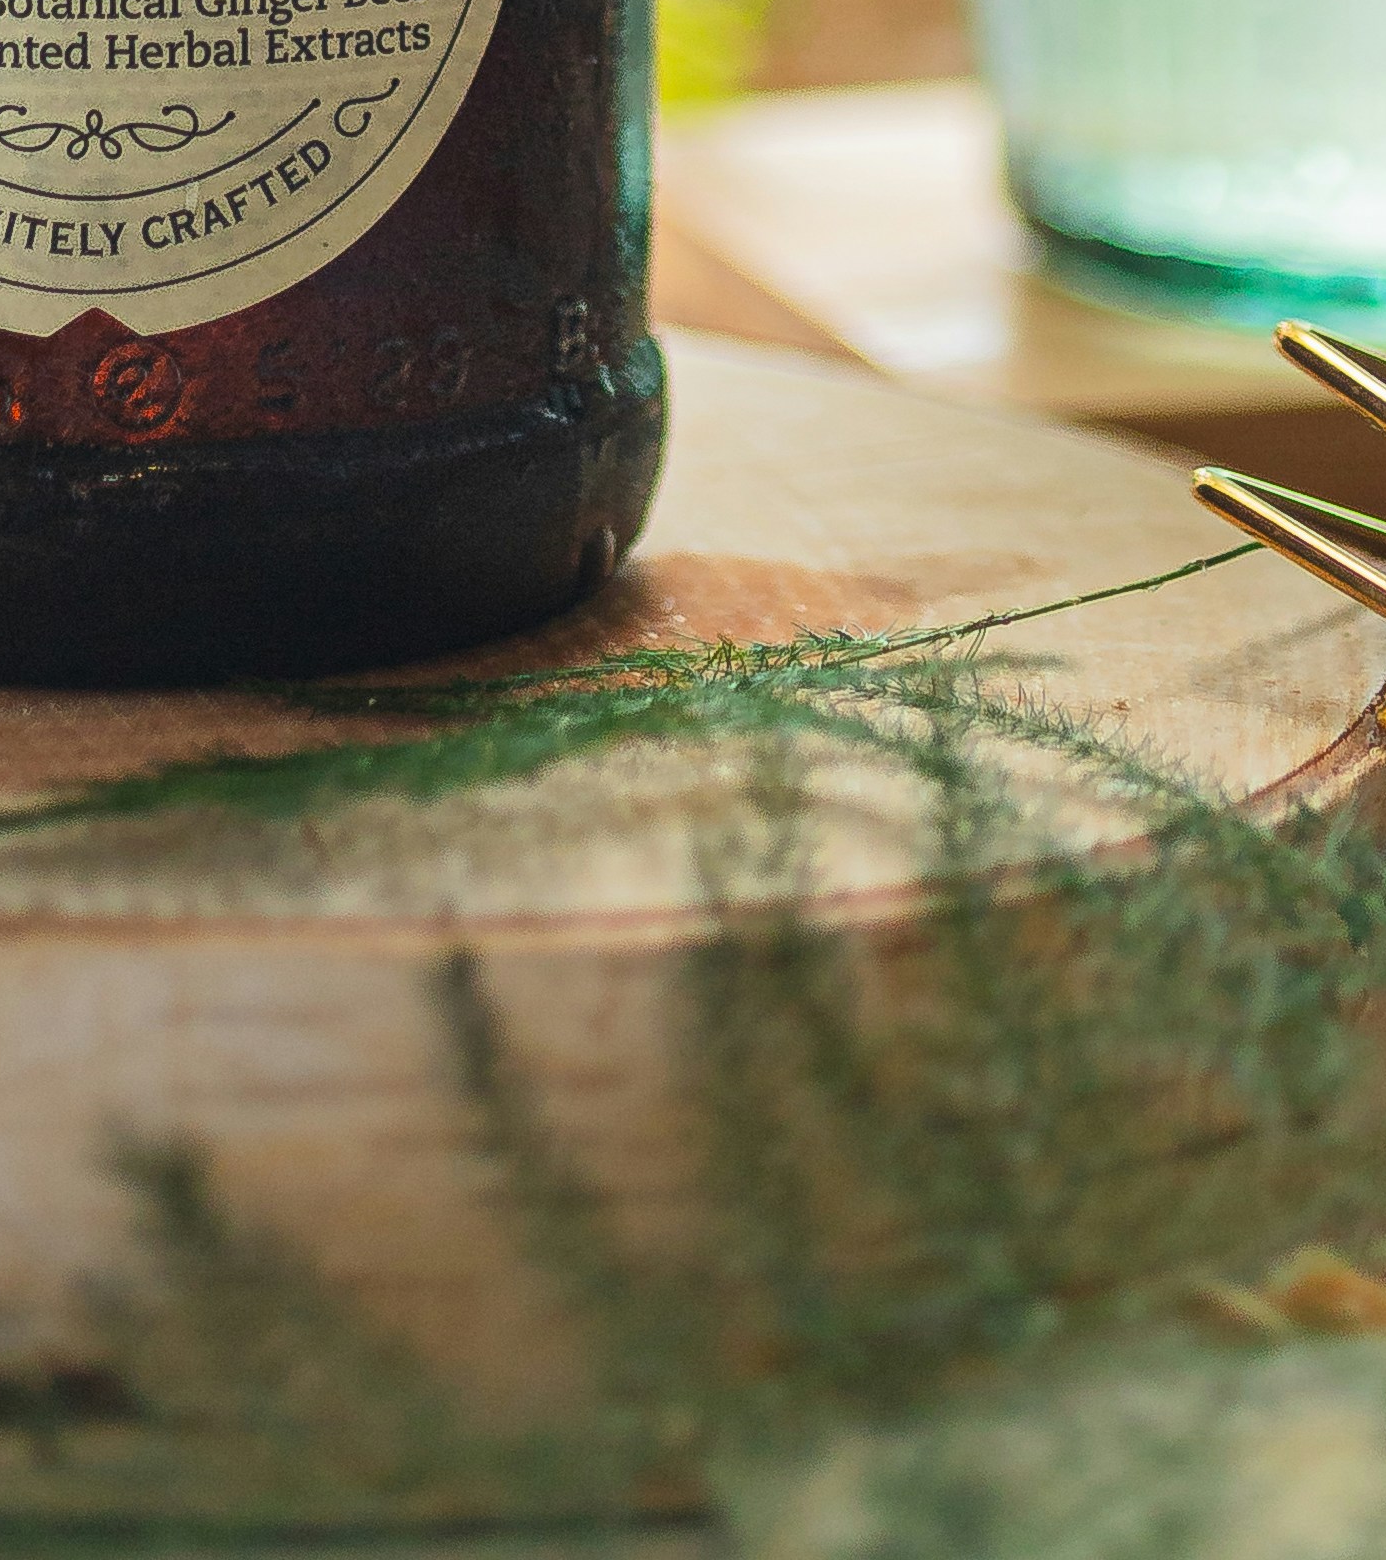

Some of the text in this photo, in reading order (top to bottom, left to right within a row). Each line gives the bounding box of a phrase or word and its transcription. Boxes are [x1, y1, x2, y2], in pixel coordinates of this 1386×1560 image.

[104, 26, 252, 72] Herbal
[265, 18, 432, 66] Extracts
[140, 136, 333, 251] CRAFTED
